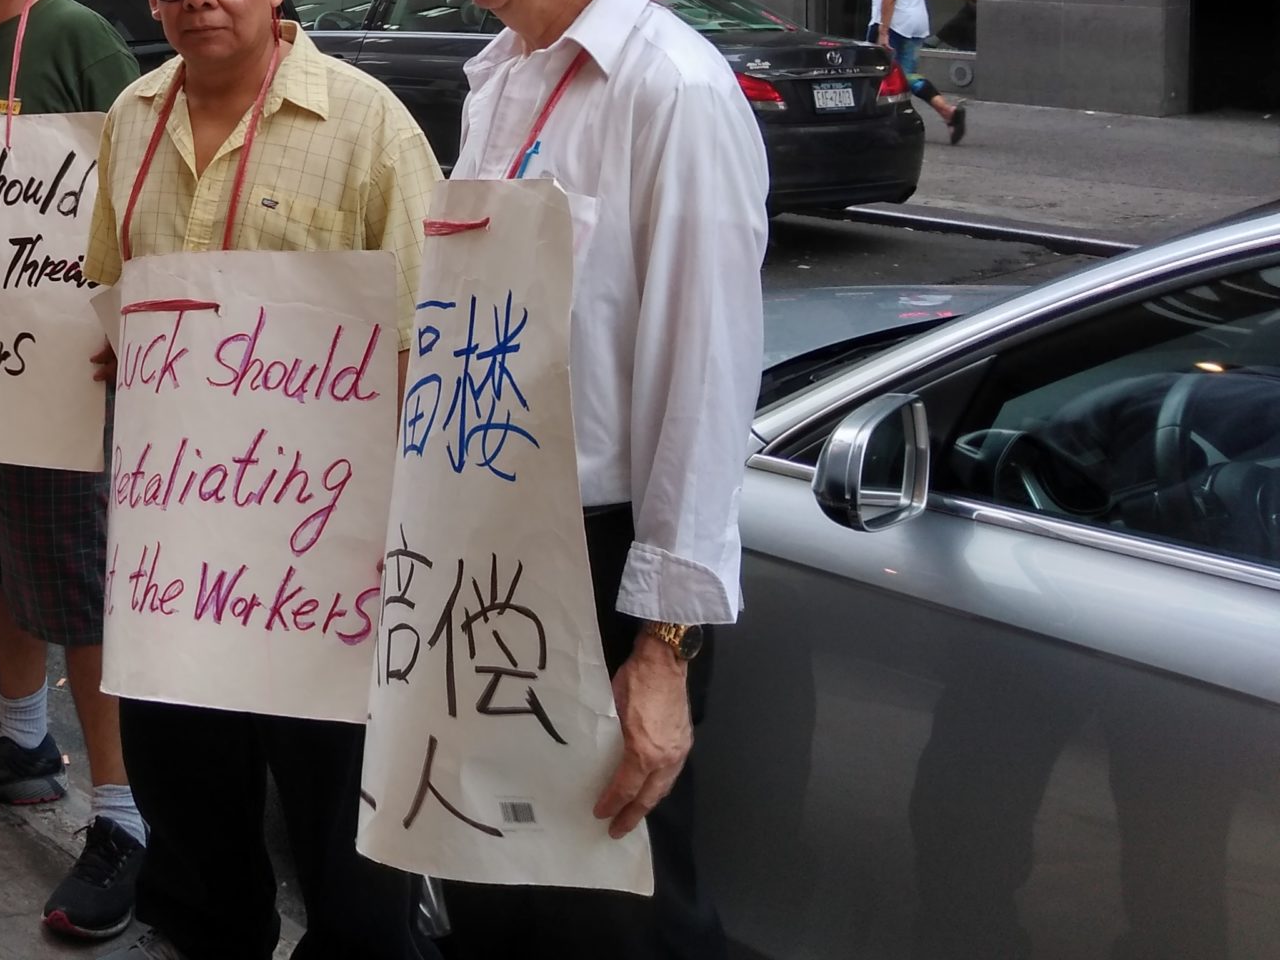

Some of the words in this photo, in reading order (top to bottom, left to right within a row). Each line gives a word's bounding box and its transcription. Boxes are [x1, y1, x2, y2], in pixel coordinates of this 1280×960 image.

[2, 233, 101, 289] Threa
[128, 541, 186, 616] the
[361, 732, 505, 838] 人
